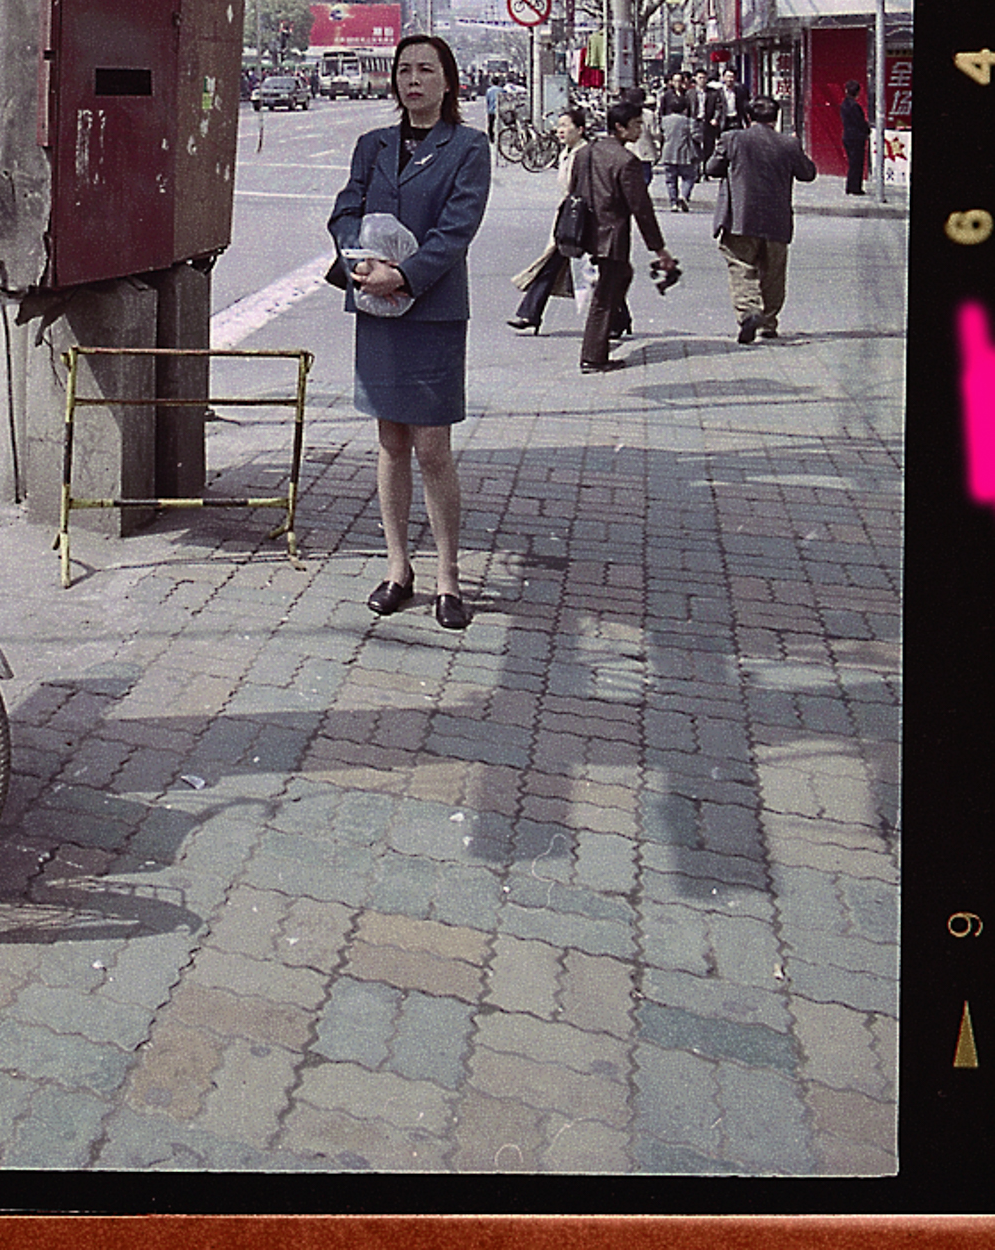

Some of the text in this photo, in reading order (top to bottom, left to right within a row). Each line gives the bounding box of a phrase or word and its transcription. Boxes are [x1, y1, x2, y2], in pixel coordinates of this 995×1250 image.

[953, 47, 995, 86] 4
[944, 209, 994, 245] 6
[946, 911, 984, 938] 9
